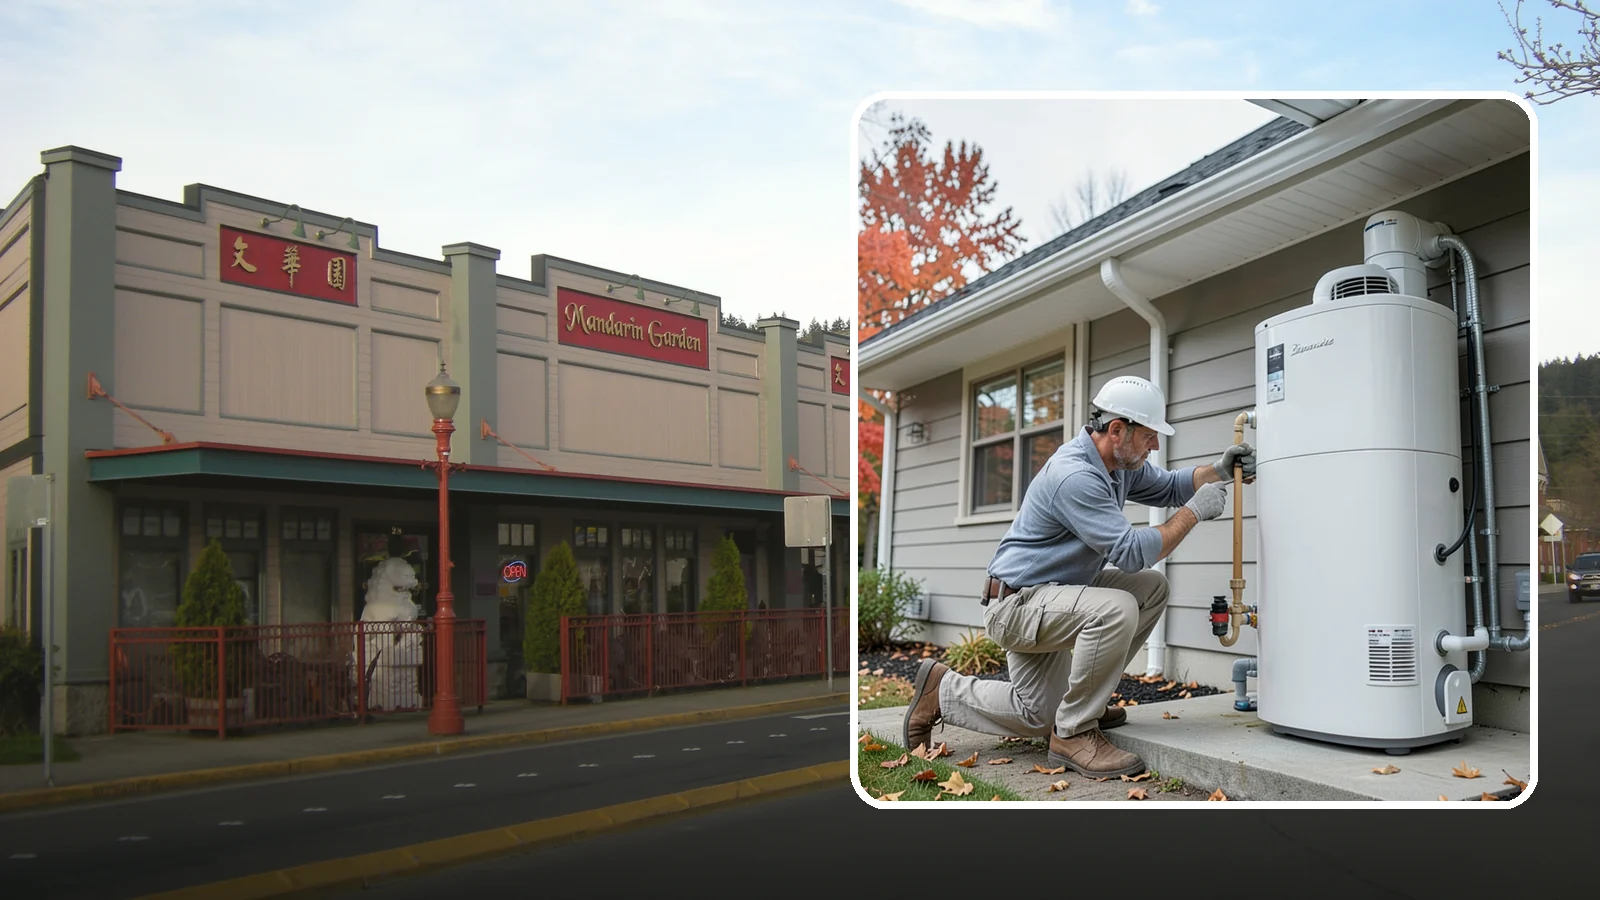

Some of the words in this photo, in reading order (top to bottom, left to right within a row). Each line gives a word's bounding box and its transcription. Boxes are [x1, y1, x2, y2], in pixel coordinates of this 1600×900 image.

[231, 236, 346, 290] 文華園
[564, 302, 644, 341] Mandarin
[648, 320, 701, 352] Garden
[503, 565, 527, 578] OPEN
